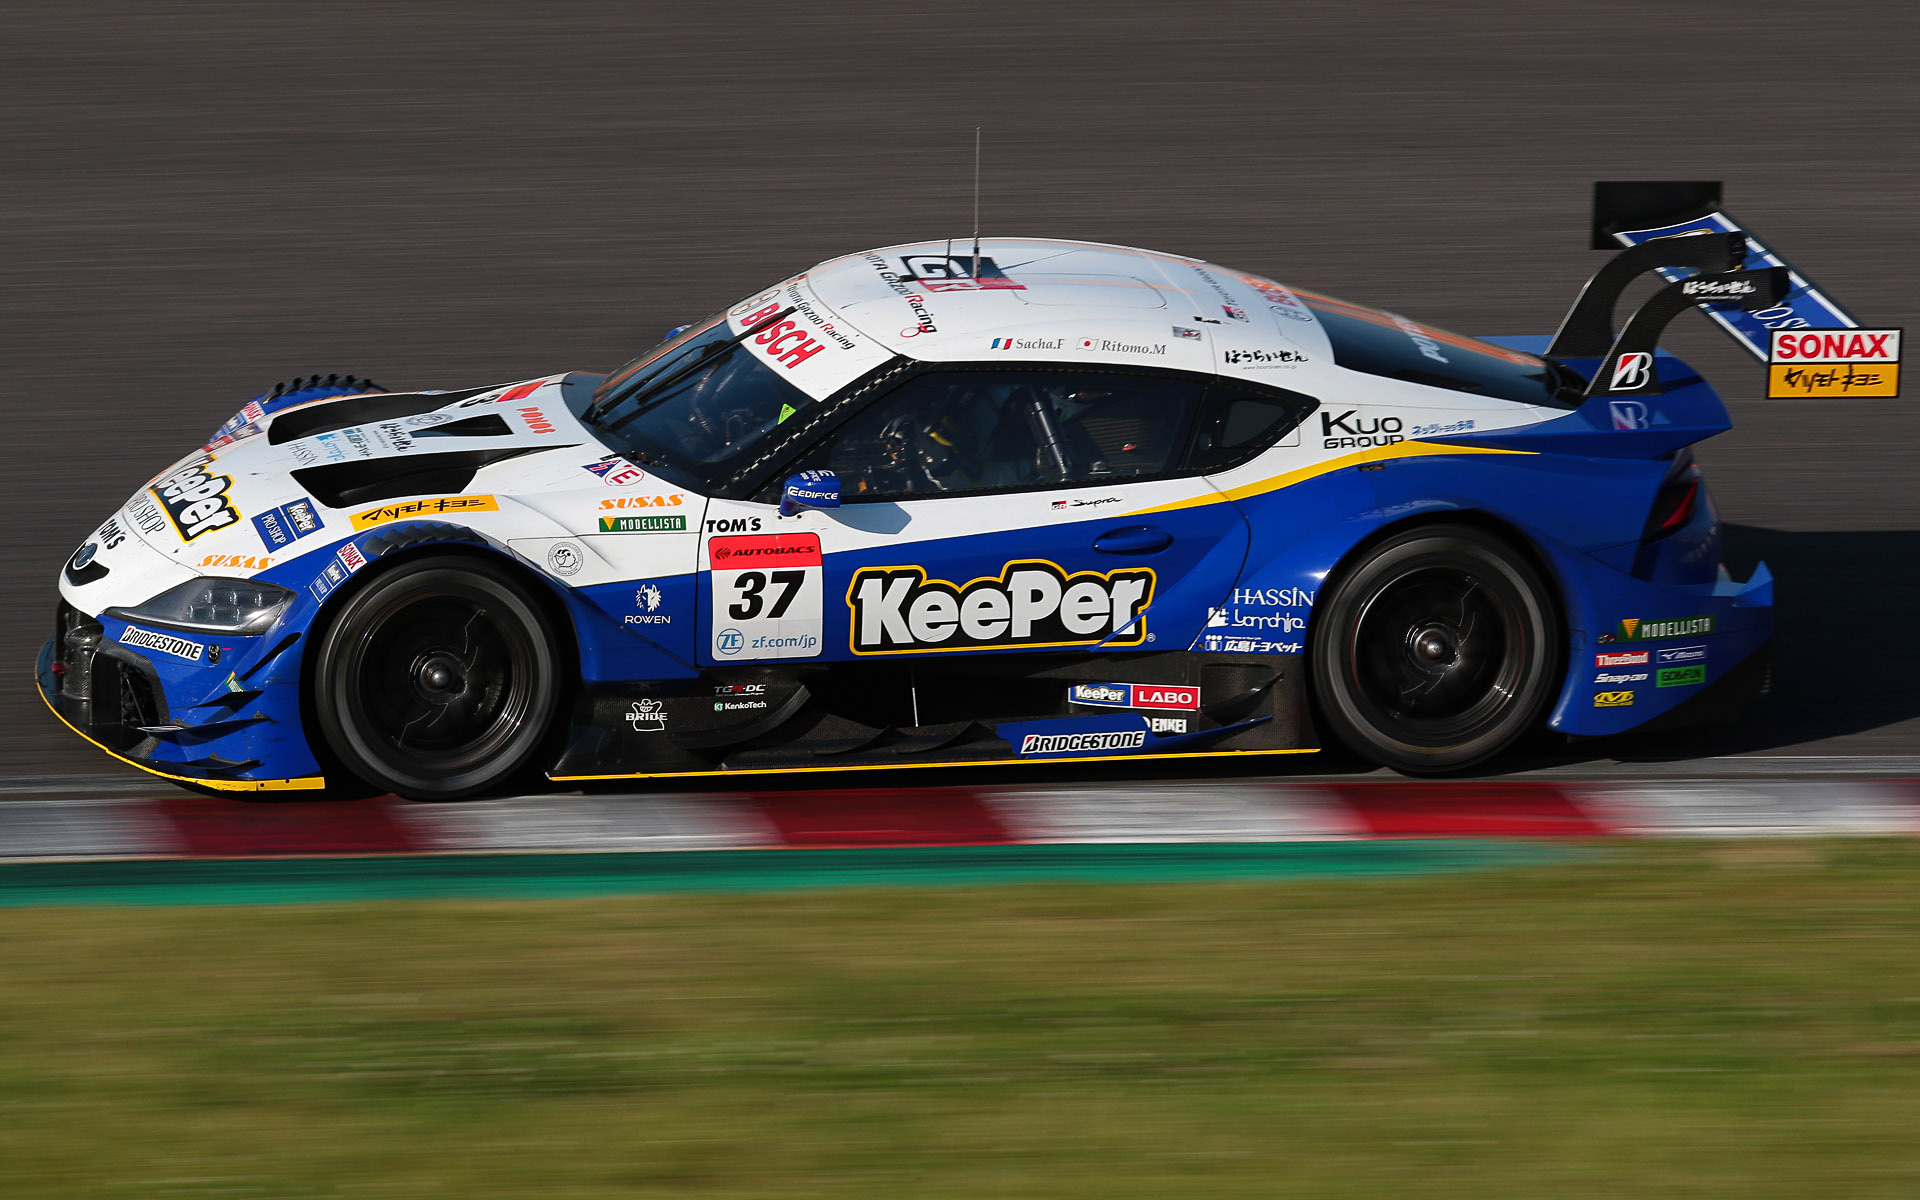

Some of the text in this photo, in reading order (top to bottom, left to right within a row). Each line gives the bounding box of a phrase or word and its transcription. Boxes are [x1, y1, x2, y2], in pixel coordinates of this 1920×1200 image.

[819, 323, 856, 350] Racing
[1015, 338, 1065, 351] Sacha.F
[1100, 340, 1167, 355] Ritomo.M
[1776, 334, 1891, 359] SONAX
[515, 407, 557, 434] PONOS
[1324, 434, 1404, 449] GROUP
[361, 499, 487, 521] マツモトキヨシ
[598, 493, 685, 511] SUSAS
[135, 504, 167, 535] SHOP
[288, 502, 316, 532] KeePer
[619, 517, 683, 531] MODELLISTA
[706, 516, 762, 533] TOM'S
[261, 513, 286, 544] PRO SHOP
[338, 543, 364, 570] SONAX
[732, 545, 816, 557] AUTOBACS
[197, 555, 275, 570] SUSAS
[729, 569, 806, 621] 37
[857, 570, 1147, 646] KeePer
[624, 615, 672, 624] ROWEN
[1641, 617, 1711, 639] MODELLISTA
[121, 627, 203, 661] BRIDGESTONE
[718, 632, 818, 651] ZF zf.com/jp
[1223, 640, 1303, 654] 広島トヨペット
[1597, 652, 1649, 666] ThreeBond
[1594, 674, 1649, 684] Snap-on
[1075, 685, 1193, 705] KeePer LABO
[725, 701, 767, 710] KenkoTech
[625, 712, 668, 721] BRIDE
[1151, 718, 1188, 733] ENKEI
[1023, 732, 1144, 752] BRIDGESTONE
